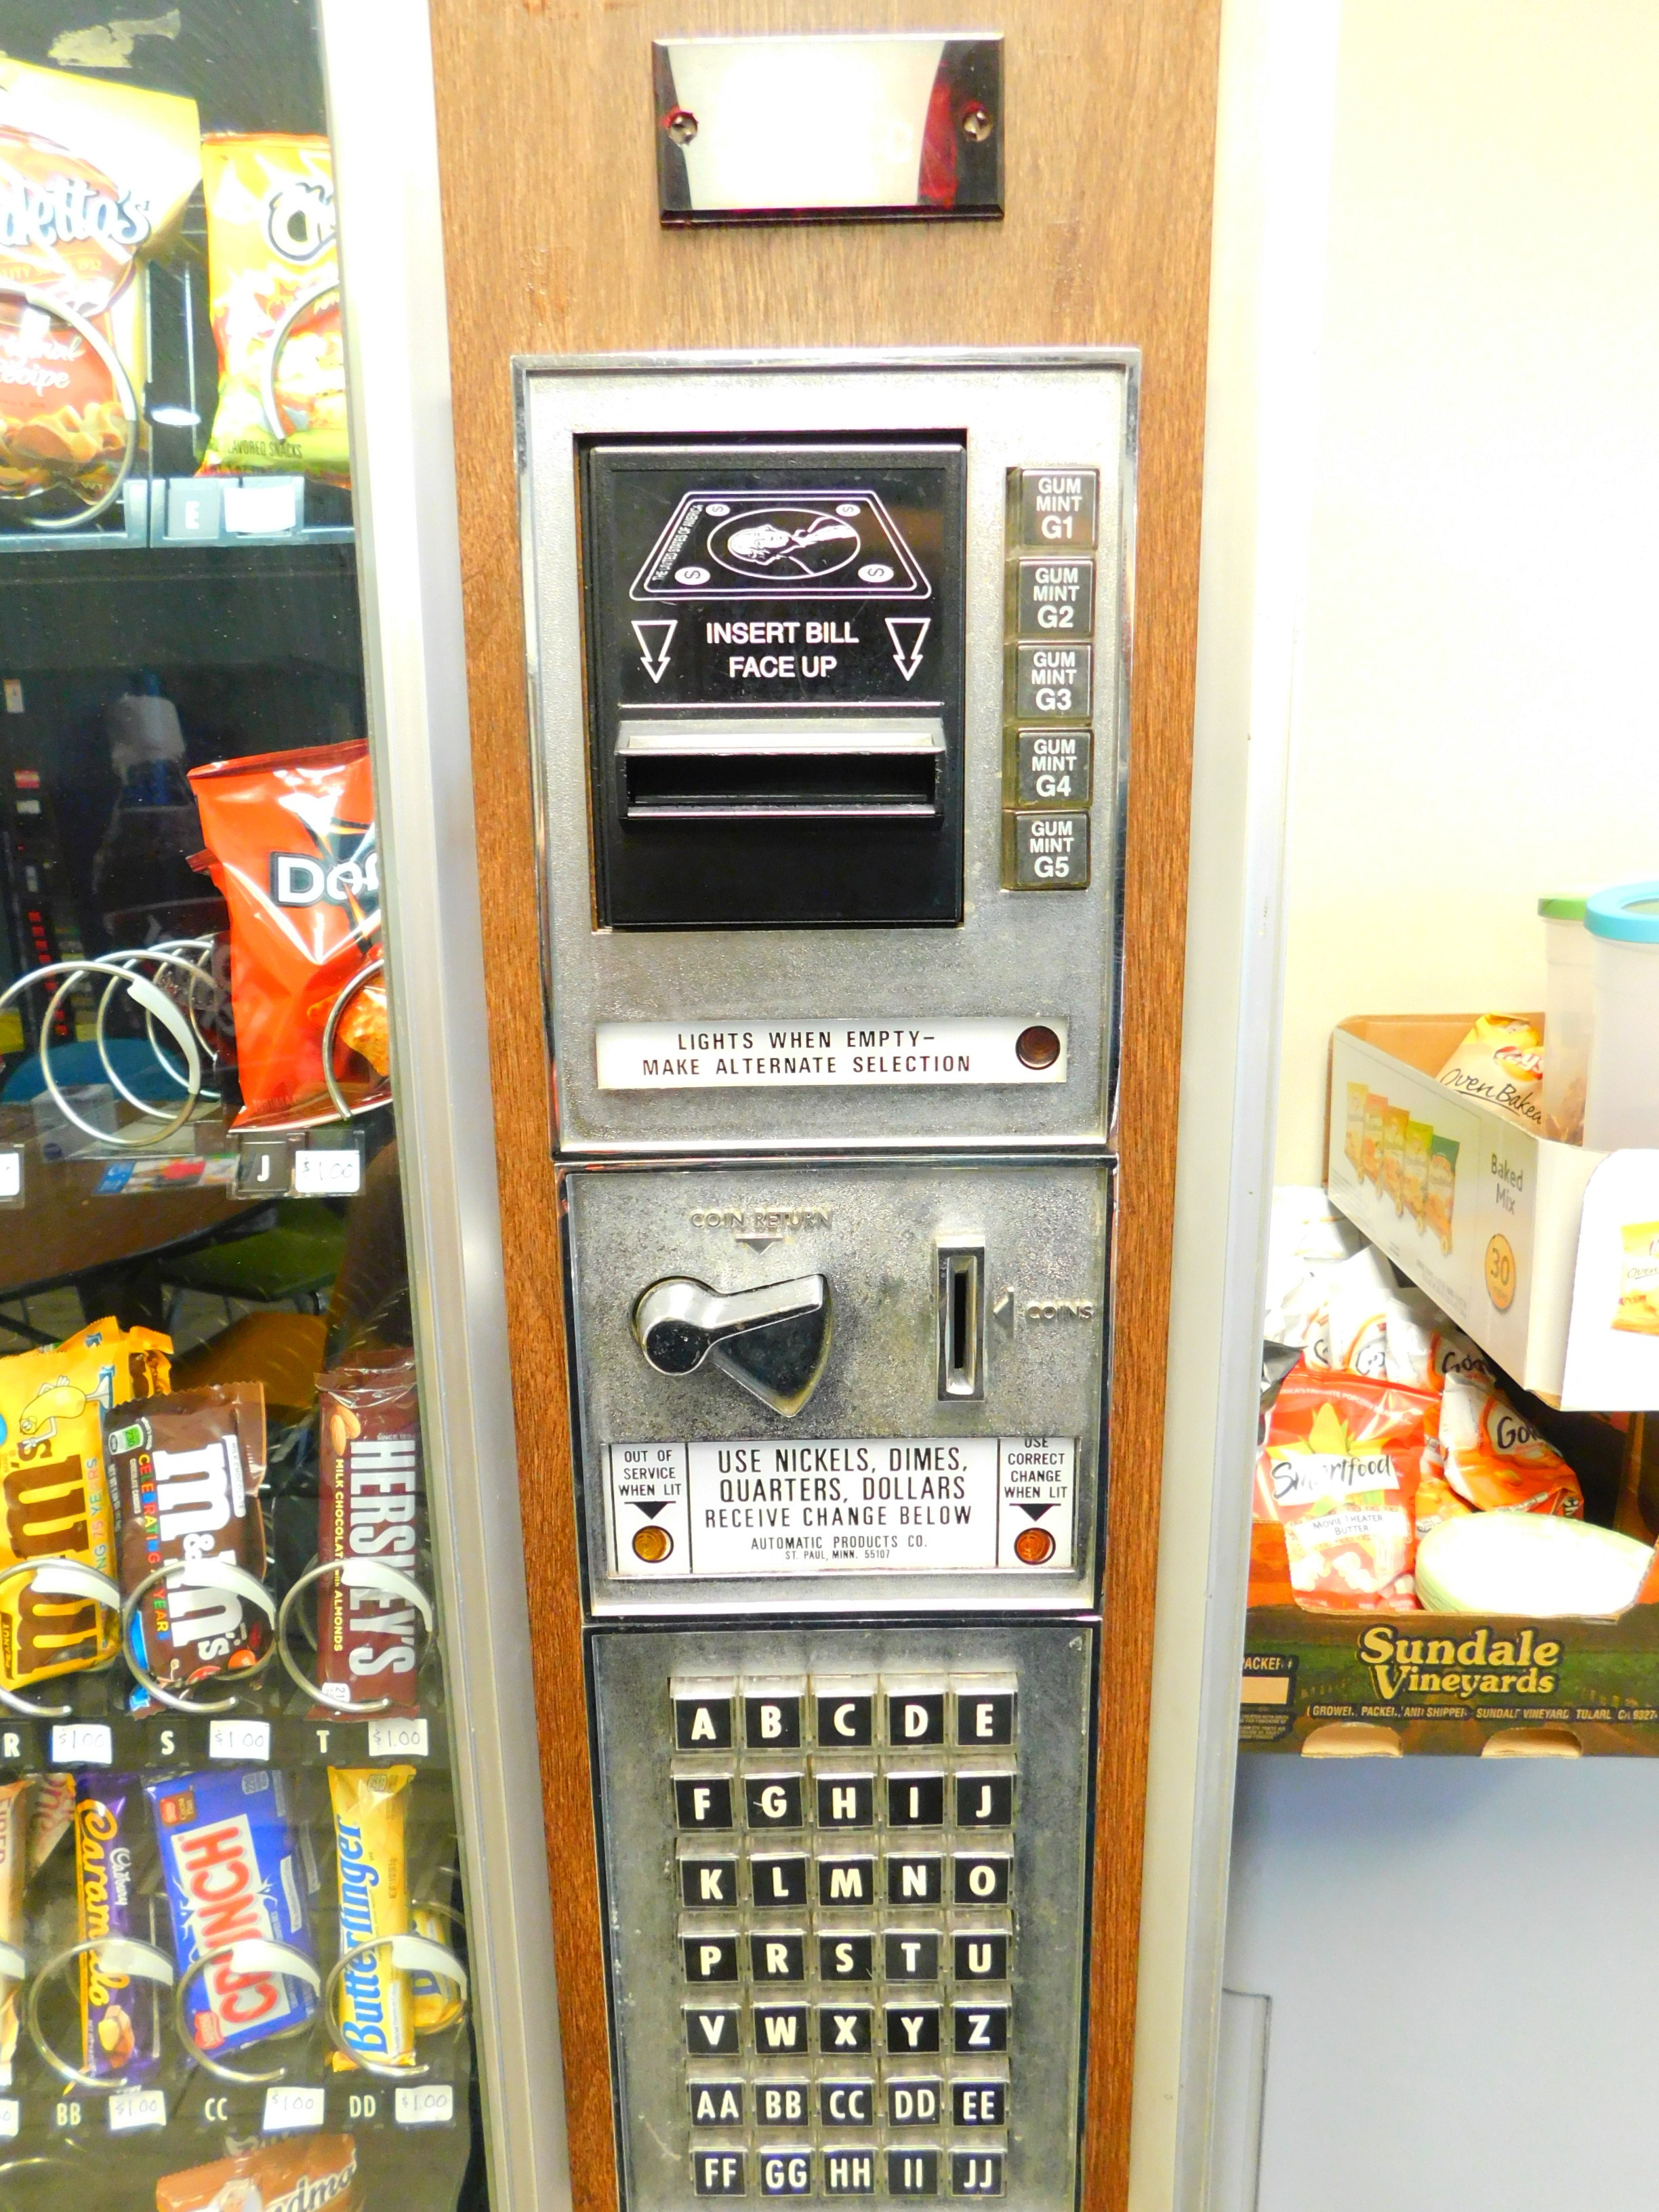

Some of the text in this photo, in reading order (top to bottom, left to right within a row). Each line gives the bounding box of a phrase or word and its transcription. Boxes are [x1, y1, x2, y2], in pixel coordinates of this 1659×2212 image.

[1038, 478, 1081, 494] GUM
[185, 500, 201, 530] E
[1036, 495, 1082, 512] MINT
[1041, 516, 1073, 539] G1
[1035, 567, 1078, 583] GUM
[1033, 586, 1080, 602] MINT
[1037, 605, 1074, 629] G2
[707, 622, 859, 644] INSERT BILL
[729, 656, 838, 678] FACE UP
[1033, 651, 1076, 668] GUM
[1031, 670, 1077, 685] MINT
[1036, 688, 1071, 711] G3
[1033, 739, 1076, 755] GUM
[1031, 756, 1077, 771] MINT
[1036, 775, 1071, 798] G4
[1031, 821, 1072, 837] GUM
[1029, 838, 1074, 853] MINT
[1033, 856, 1069, 878] G5
[678, 1032, 754, 1050] LIGHTS
[769, 1031, 832, 1049] WHEN
[642, 1054, 971, 1076] MAKE ALTERNATE SELECTION
[1439, 1068, 1494, 1097] Oven
[257, 1154, 270, 1182] J
[1491, 1153, 1524, 1192] Baked
[1496, 1183, 1516, 1216] Mix
[690, 1209, 832, 1229] COIN RETURN
[1490, 1248, 1510, 1286] 30
[1025, 1303, 1094, 1321] COINS
[1024, 1437, 1049, 1449] USE
[624, 1449, 673, 1463] OUT OF
[718, 1446, 968, 1473] USE NICKELS, DIMES,
[1007, 1452, 1065, 1466] CORRECT
[335, 1458, 344, 1488] MILK
[623, 1467, 676, 1480] SERVICE
[1010, 1470, 1062, 1483] CHANGE
[618, 1483, 682, 1497] WHEN LIT
[719, 1475, 966, 1504] QUARTERS, DOLLARS
[1004, 1486, 1068, 1498] WHEN LIT
[334, 1491, 344, 1562] CHOCOLAT
[705, 1505, 972, 1528] RECEIVE CHANGE BELOW
[1313, 1517, 1342, 1530] MOVIE
[1334, 1525, 1370, 1536] BUTTER
[750, 1534, 928, 1551] AUTOMATIC PRODUCTS CO.
[785, 1549, 890, 1561] ST. PAUL, MINN. 55107
[333, 1590, 344, 1652] ALMONDS
[1360, 1626, 1560, 1667] Sundale
[1370, 1665, 1555, 1699] Vineyards
[691, 1703, 994, 1740] A B C D E
[3, 1732, 21, 1757] R
[161, 1730, 175, 1755] S
[316, 1729, 330, 1753] T
[373, 1729, 420, 1748] $1.00
[693, 1785, 991, 1820] F G H I J
[700, 1866, 996, 1899] K L M N O
[699, 1942, 992, 1975] P R S T U
[699, 2015, 990, 2047] V W X Y Z
[57, 2102, 81, 2126] BB
[205, 2097, 228, 2122] CC
[349, 2095, 376, 2118] DD
[697, 2089, 995, 2120] AA BB CC DD EE
[704, 2158, 992, 2189] FF GG HH II JJ
